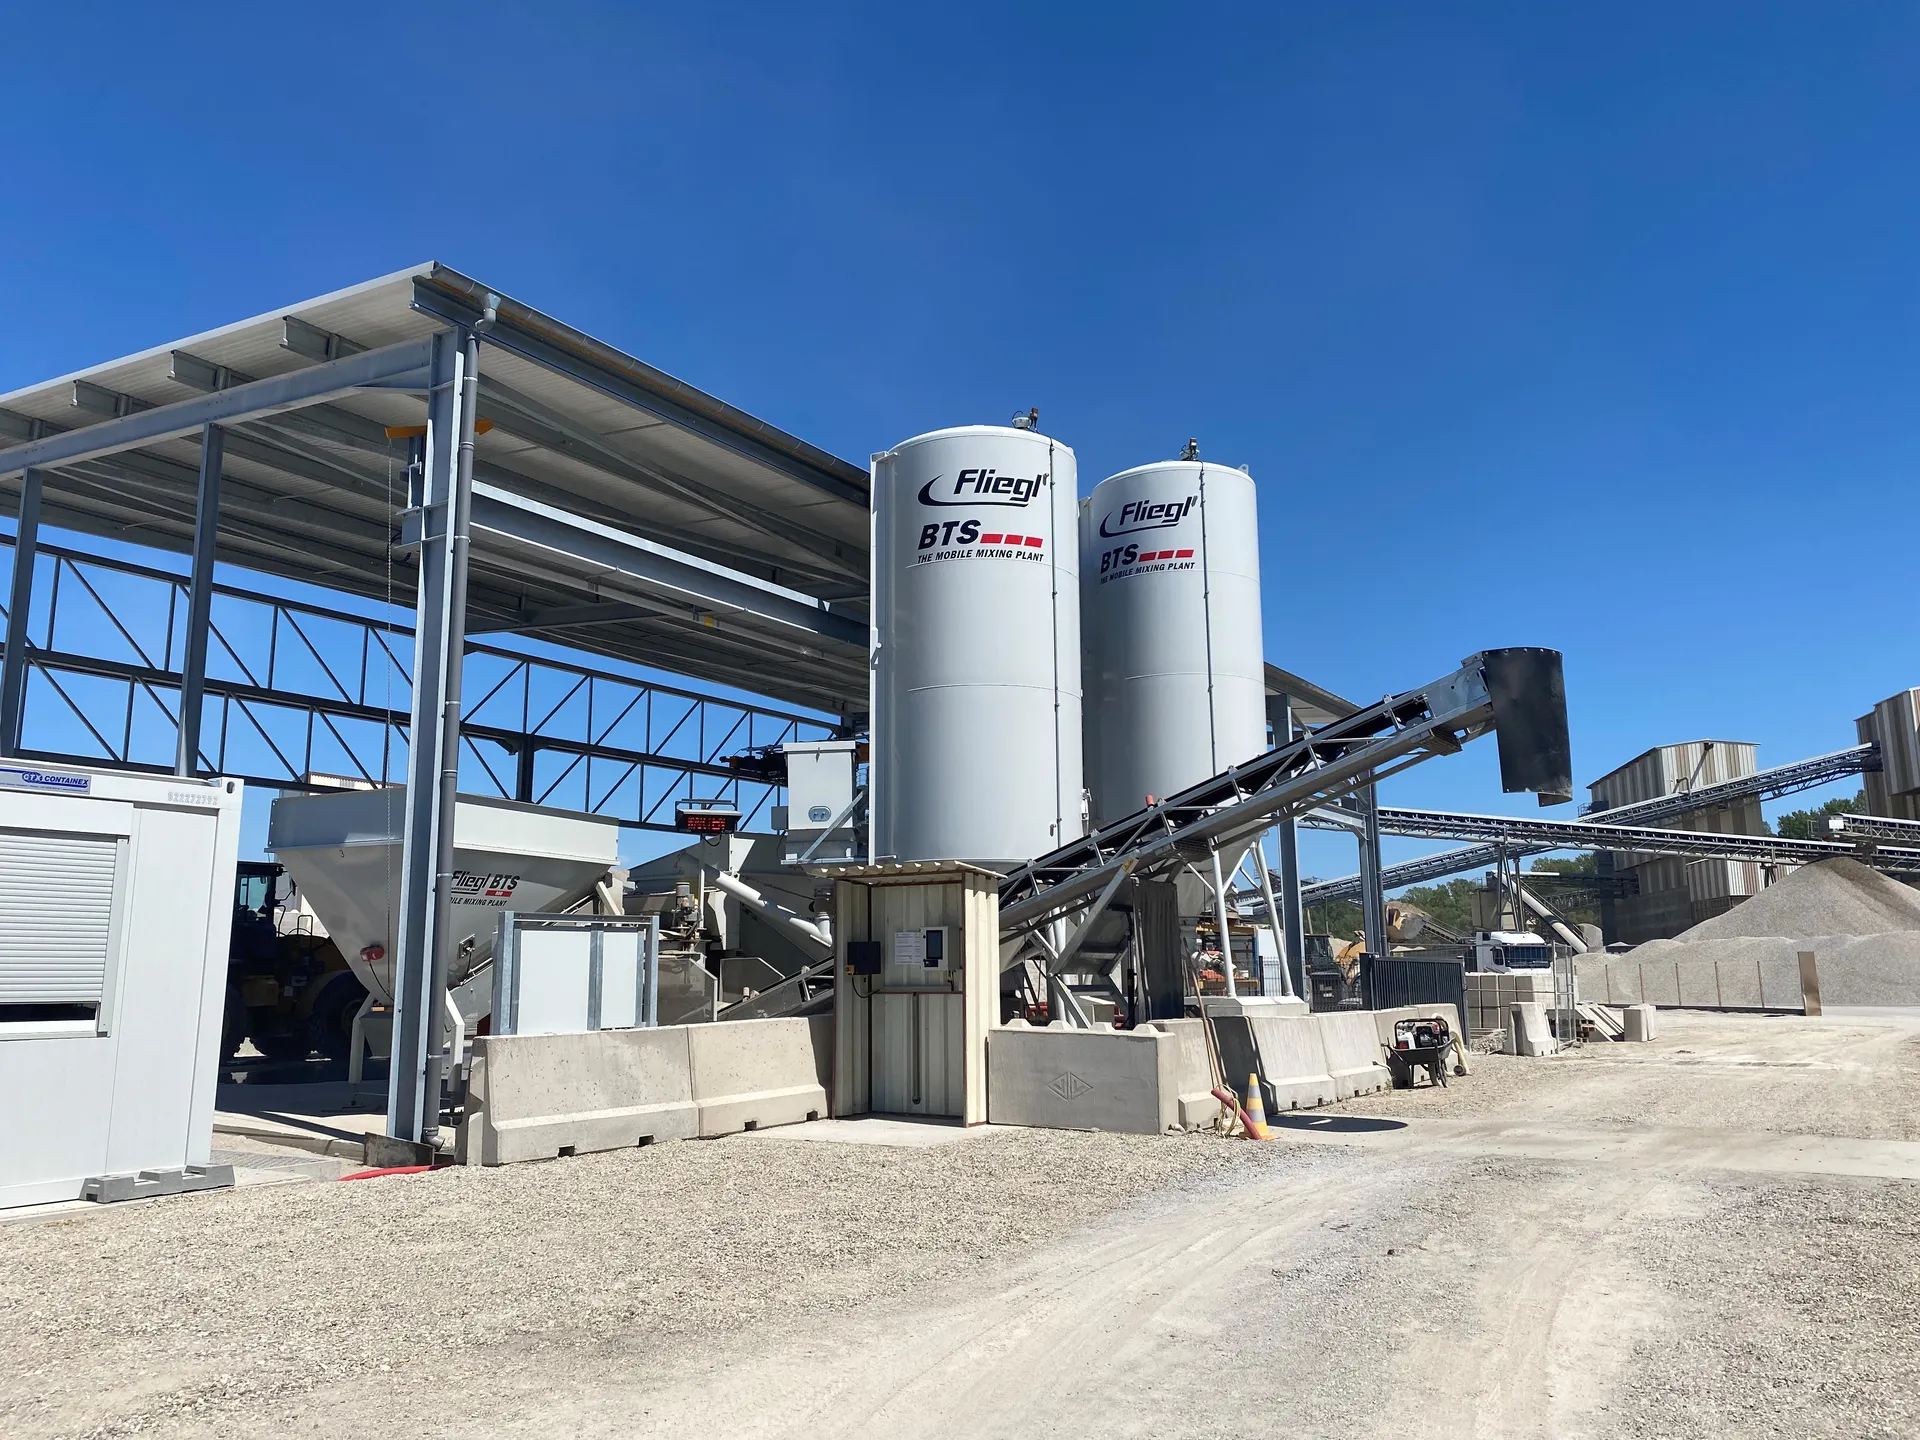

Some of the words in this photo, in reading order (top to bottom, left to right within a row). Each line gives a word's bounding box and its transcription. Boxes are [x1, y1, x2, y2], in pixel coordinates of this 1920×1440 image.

[953, 469, 1042, 502] Fliegl
[1119, 496, 1193, 526] Fliegl
[918, 519, 981, 550] BTS
[918, 553, 933, 564] THE
[935, 549, 973, 561] MOBILE
[975, 549, 1013, 559] MIXING
[1015, 551, 1044, 562] PLANT
[1100, 544, 1139, 575] BTS
[1109, 568, 1133, 581] MOBILE
[1135, 563, 1165, 574] MIXING
[1167, 562, 1195, 571] PLANT
[44, 775, 89, 786] CONTAINEX
[452, 870, 491, 892] Fliegl
[489, 874, 520, 890] BTS
[463, 898, 486, 906] MIXING
